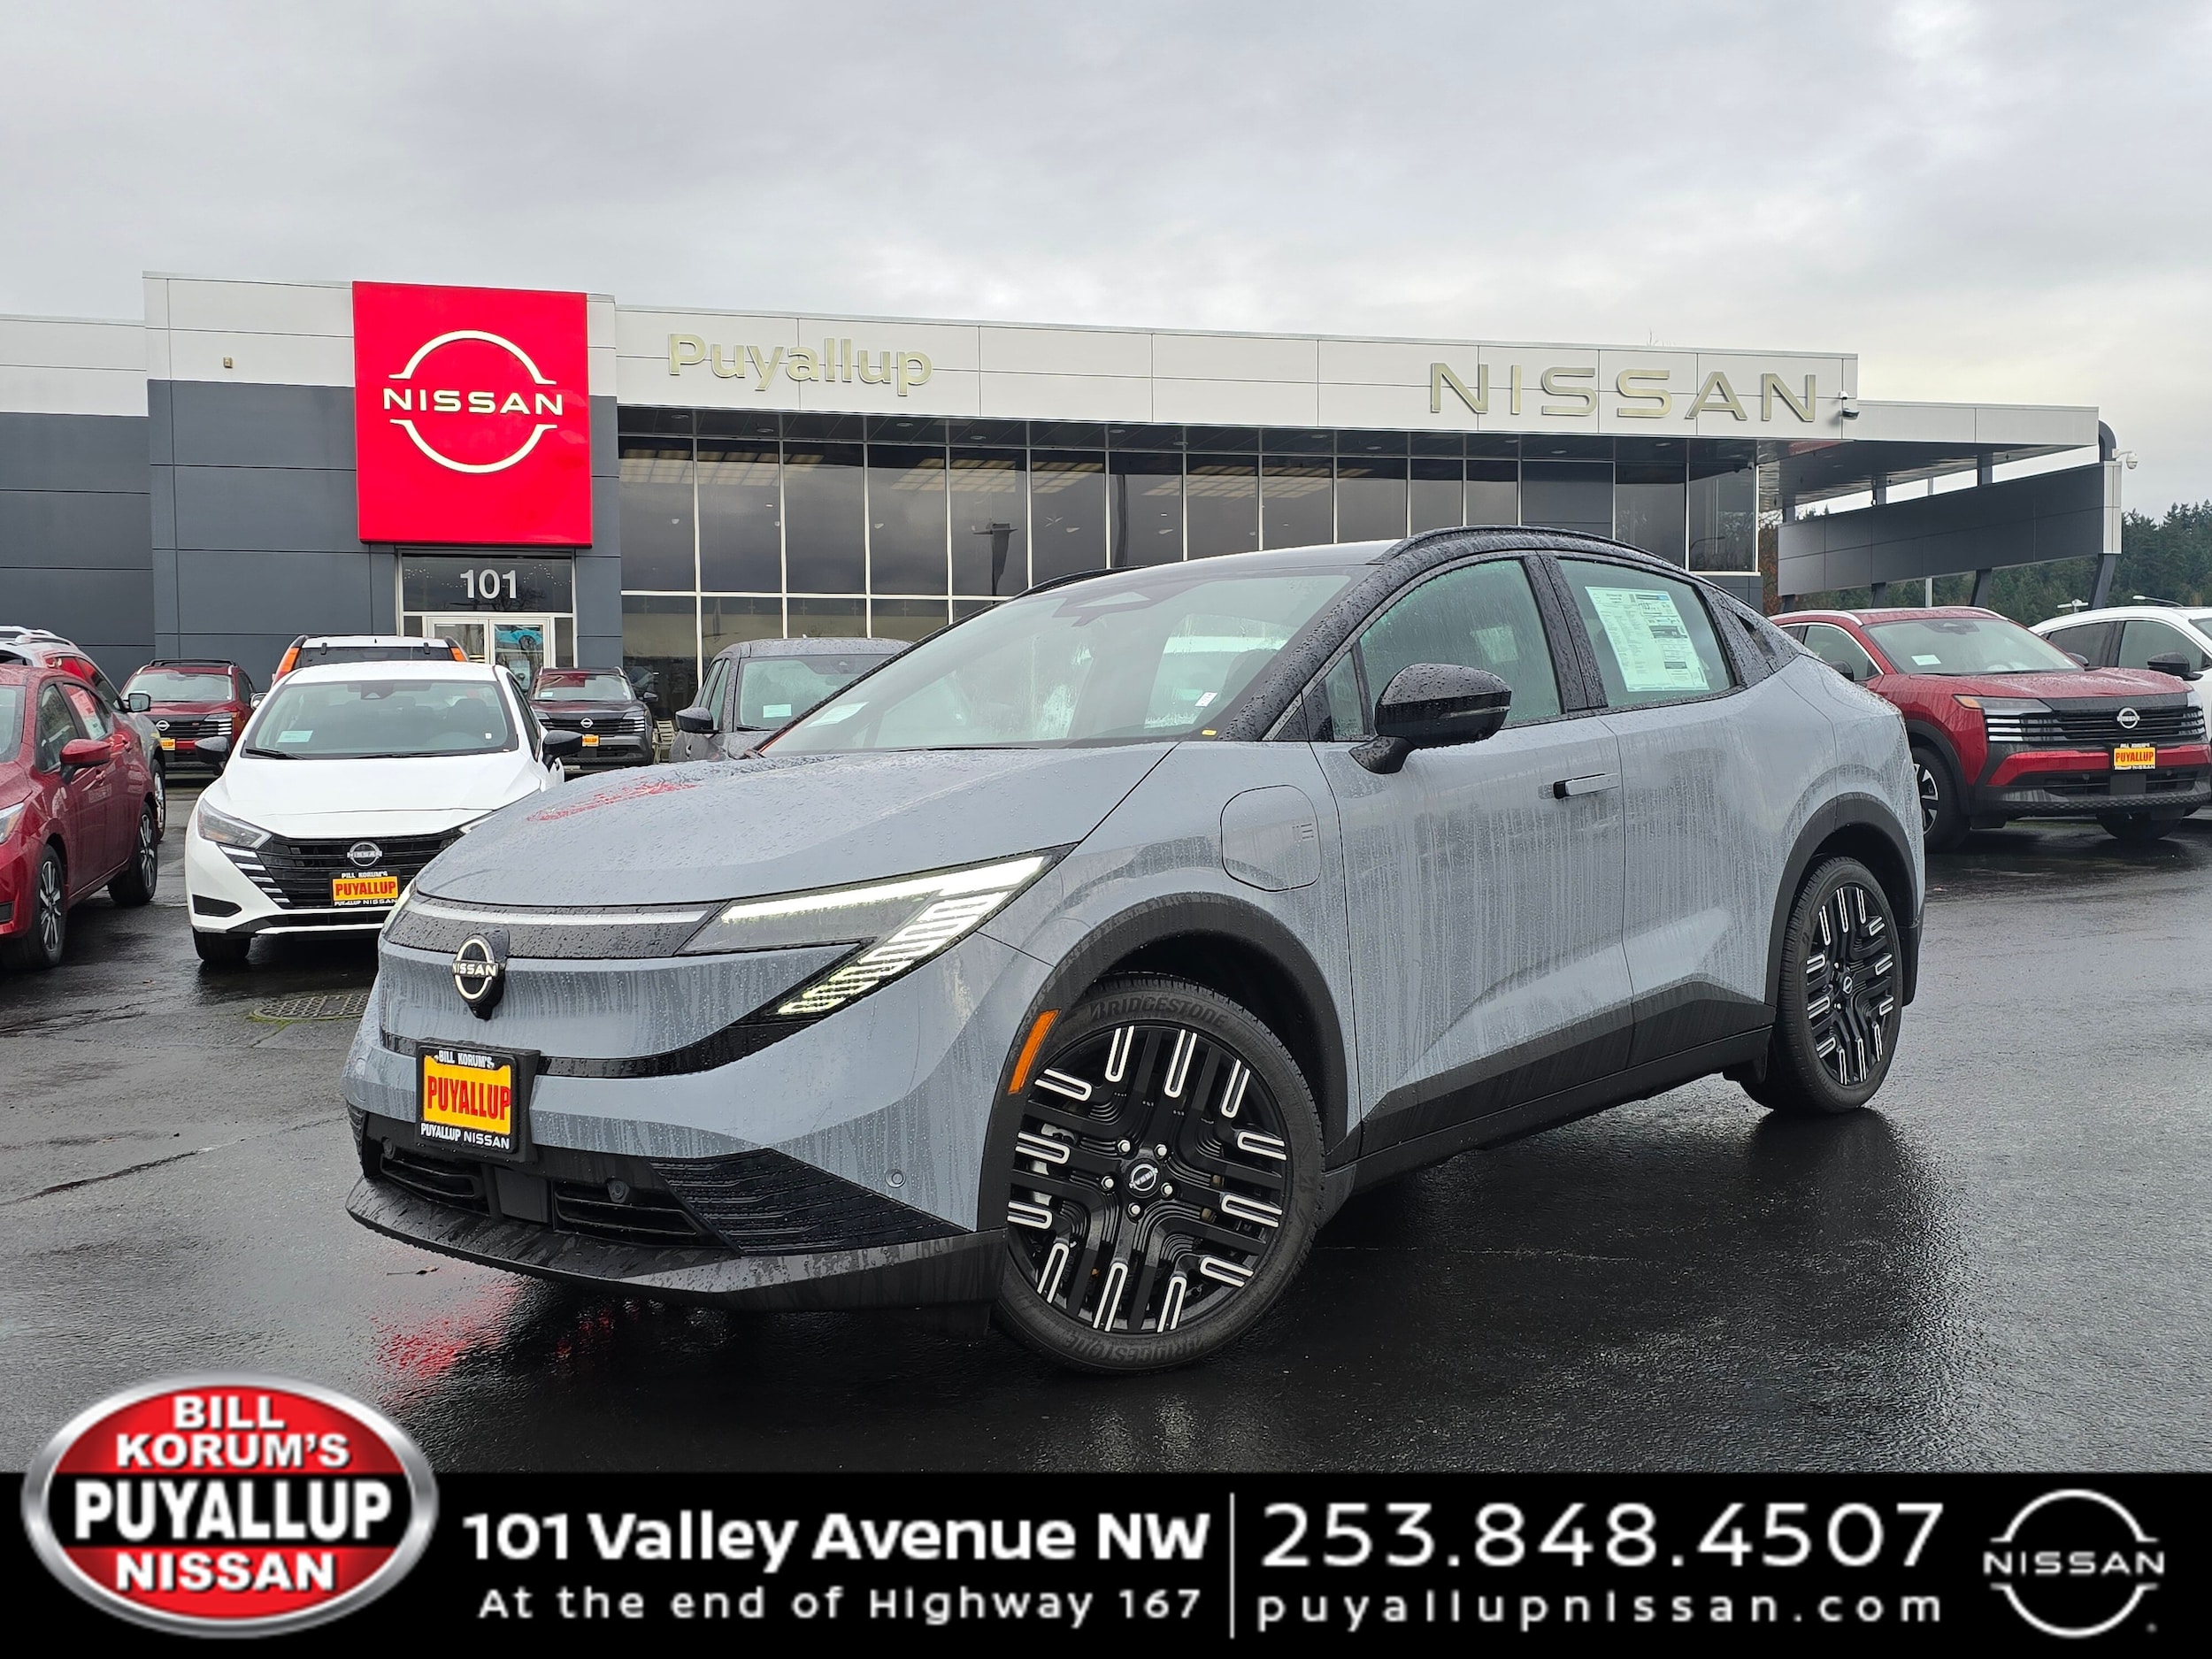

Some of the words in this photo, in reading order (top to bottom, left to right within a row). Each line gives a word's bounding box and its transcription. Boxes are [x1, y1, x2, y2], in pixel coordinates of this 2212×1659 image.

[669, 334, 933, 396] Puyallup
[383, 388, 564, 416] NISSAN
[1430, 362, 1816, 422] NISSAN
[460, 569, 518, 600] 101
[2115, 750, 2154, 763] PUYALLUP
[335, 881, 396, 896] PUYALLUP
[452, 961, 496, 976] NISSAN
[1090, 996, 1229, 1027] BRIDGESTONE
[439, 1050, 455, 1064] BILL
[457, 1052, 495, 1069] KORUM'S
[427, 1075, 511, 1121] PUYALLUP
[420, 1122, 461, 1141] PUYALLUP
[464, 1131, 511, 1150] NISSAN
